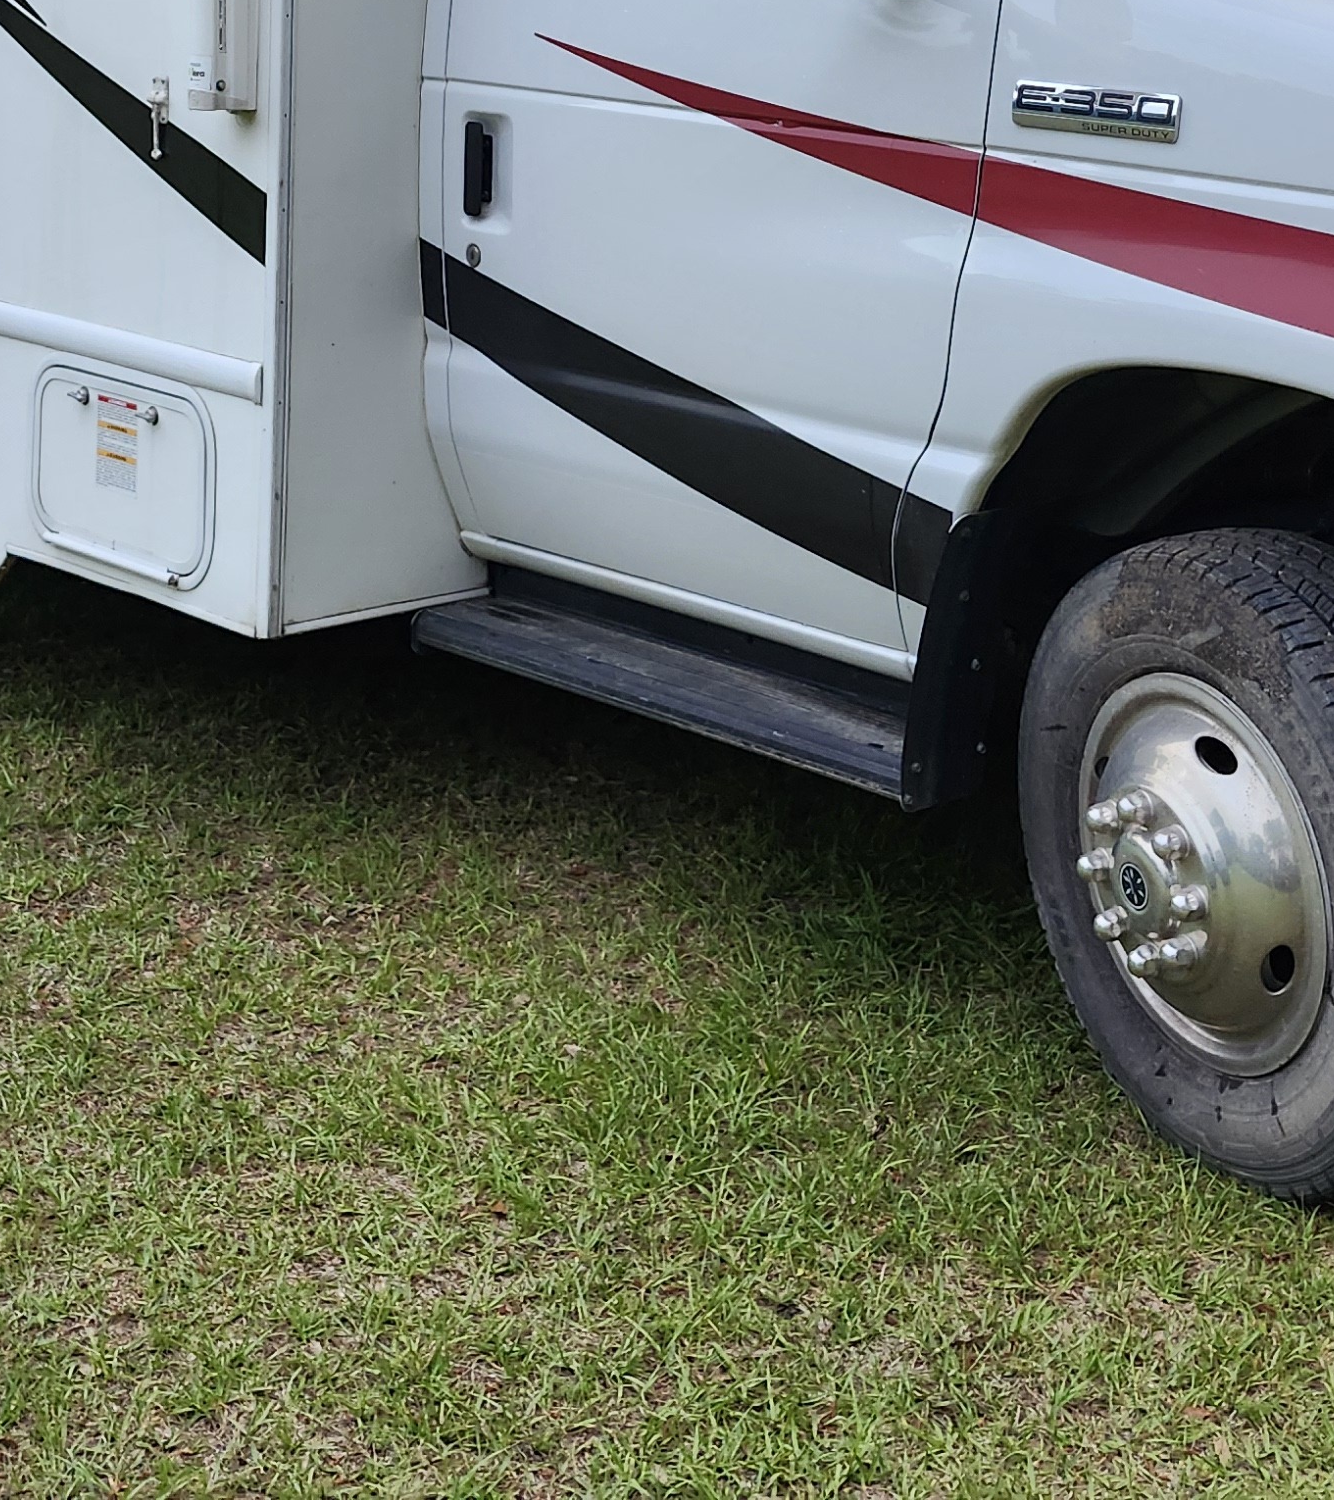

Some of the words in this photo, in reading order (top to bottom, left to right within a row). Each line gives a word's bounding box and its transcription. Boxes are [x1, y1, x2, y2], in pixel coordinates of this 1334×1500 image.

[1017, 84, 1174, 125] E-350
[1081, 122, 1127, 135] SUPER
[1131, 127, 1169, 139] DUTY
